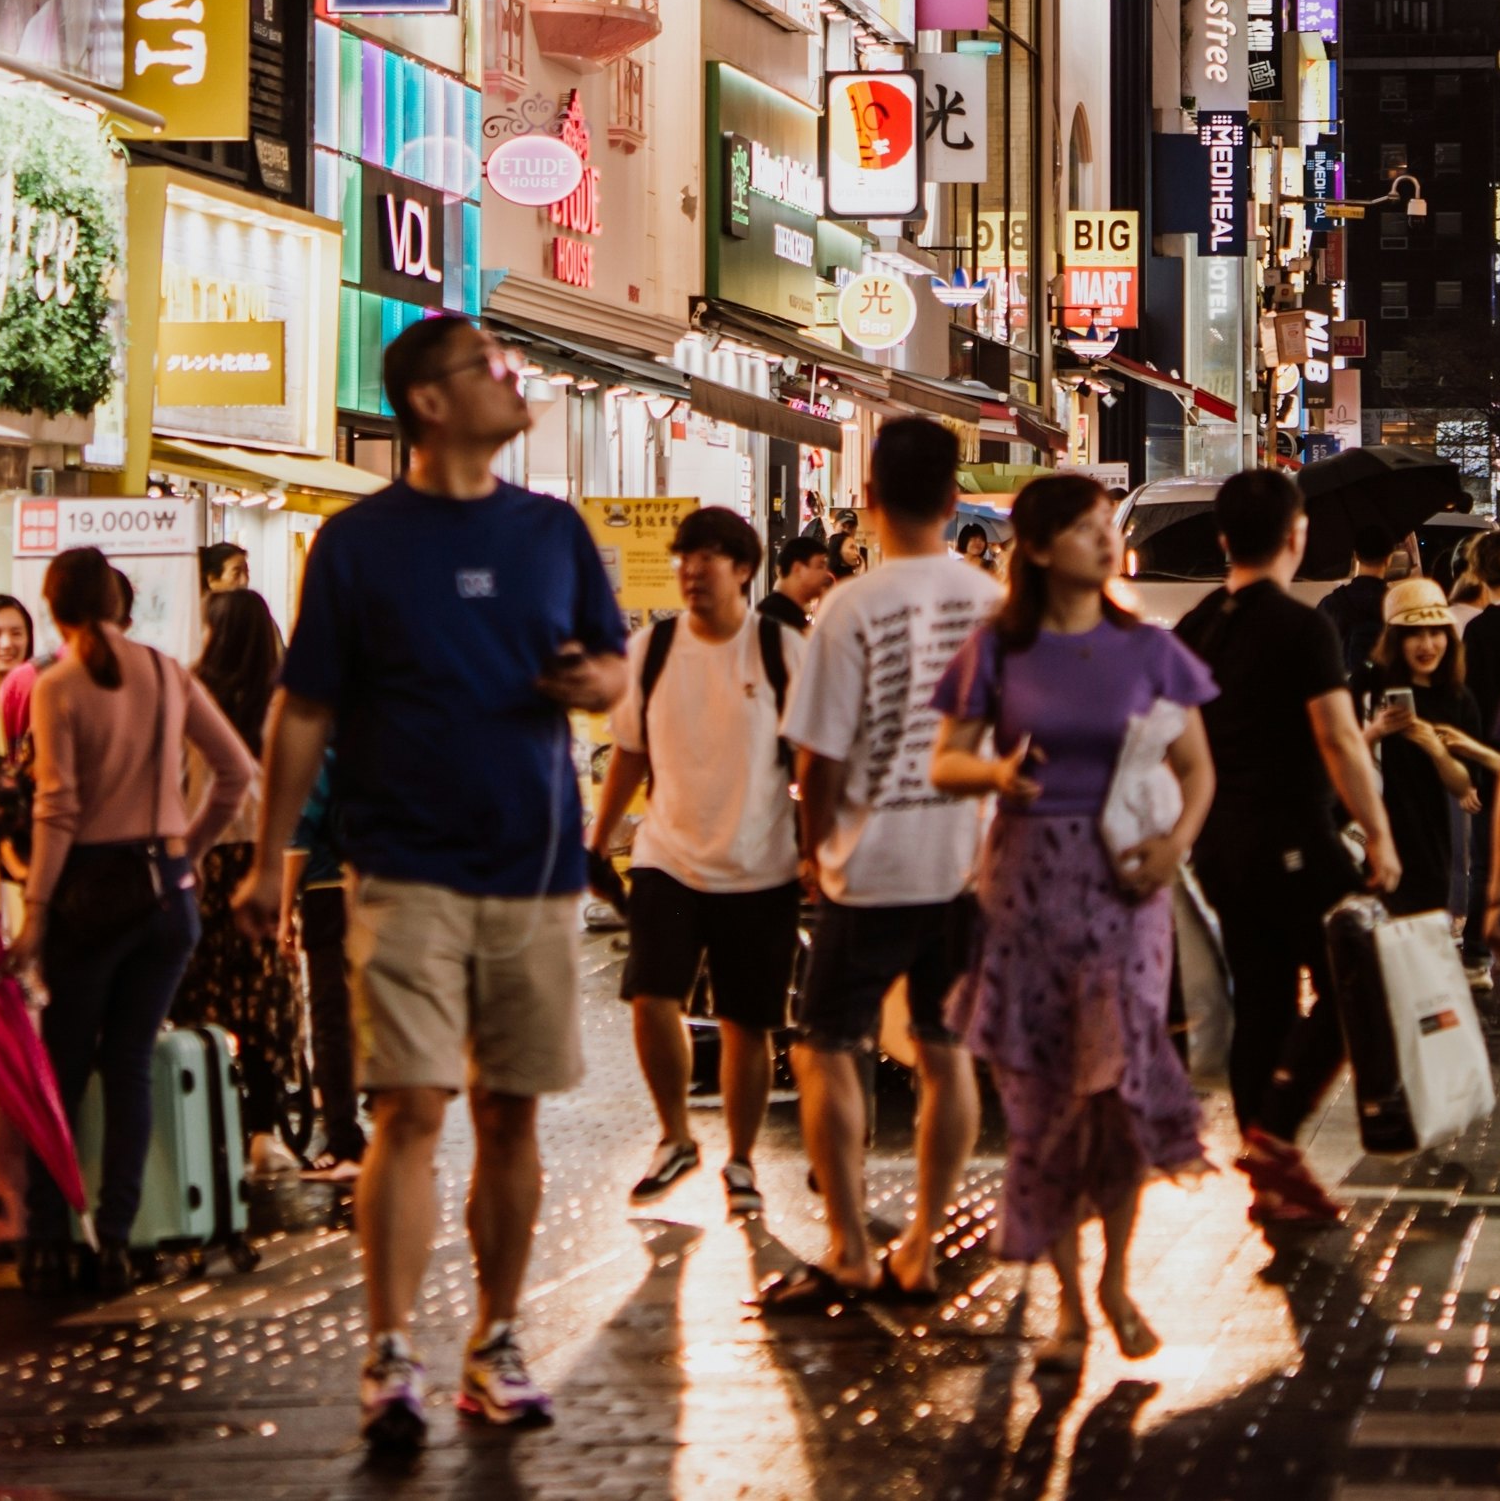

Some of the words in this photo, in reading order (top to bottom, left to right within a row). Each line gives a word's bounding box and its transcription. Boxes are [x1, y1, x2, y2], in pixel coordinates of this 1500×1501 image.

[925, 83, 974, 150] 光
[500, 157, 570, 176] ETUDE
[509, 176, 559, 189] HOUSE
[1211, 126, 1234, 252] MEDIHEAL
[386, 192, 442, 283] VDL
[1074, 219, 1131, 251] BIG
[554, 236, 595, 289] HOUSE
[860, 281, 893, 316] 光
[1070, 270, 1132, 306] MART
[858, 320, 892, 336] Bag
[166, 352, 271, 374] タレント化粧品
[1304, 310, 1329, 384] MLB
